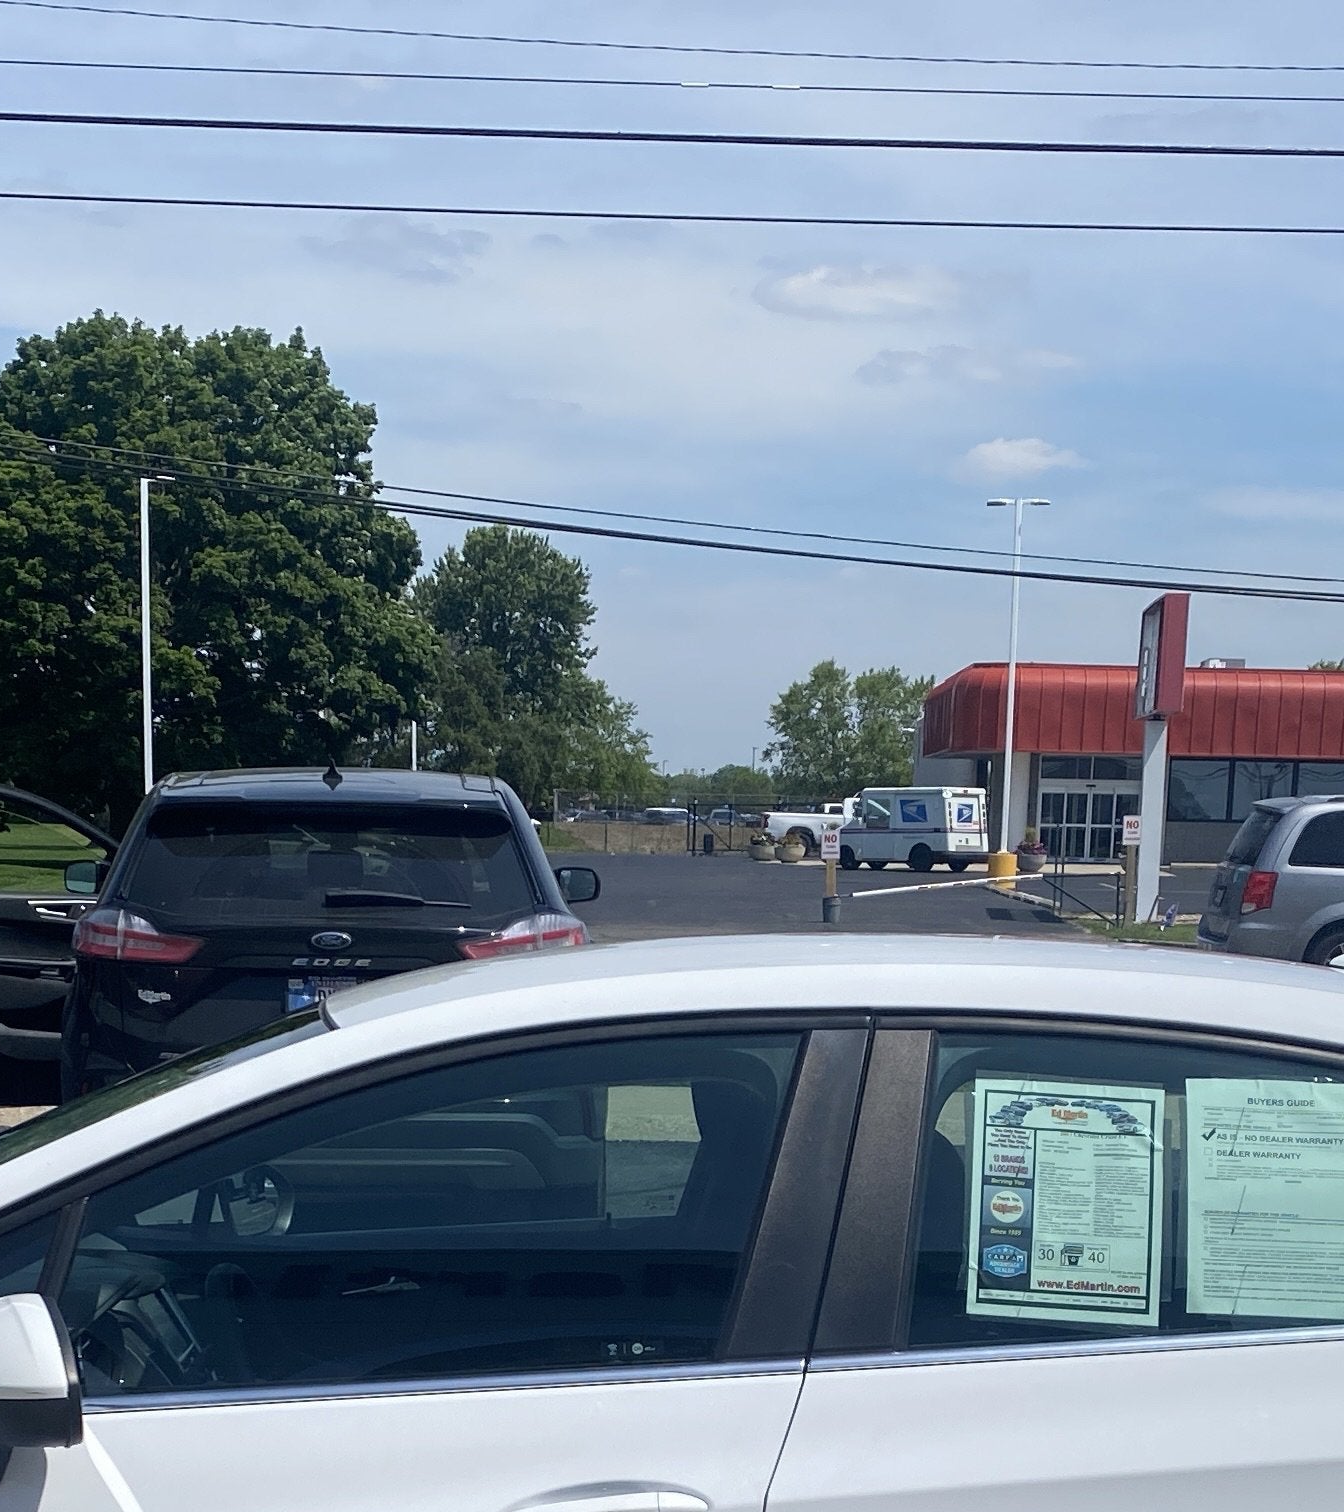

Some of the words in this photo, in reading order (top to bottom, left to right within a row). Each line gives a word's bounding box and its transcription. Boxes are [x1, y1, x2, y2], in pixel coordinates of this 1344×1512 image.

[1126, 820, 1139, 829] NO
[824, 834, 837, 843] NO
[292, 958, 372, 967] EDGE
[1247, 1097, 1284, 1107] BUYERS
[1286, 1099, 1316, 1107] GUIDE
[1244, 1135, 1257, 1143] NO
[1259, 1136, 1293, 1144] DEALER
[1295, 1137, 1344, 1146] WARRANTY
[1216, 1149, 1251, 1158] DEALER
[1253, 1151, 1302, 1160] WARRANTY
[1038, 1248, 1055, 1261] 30
[1088, 1251, 1105, 1264] 40
[1037, 1280, 1141, 1294] www.EdMartin.com
